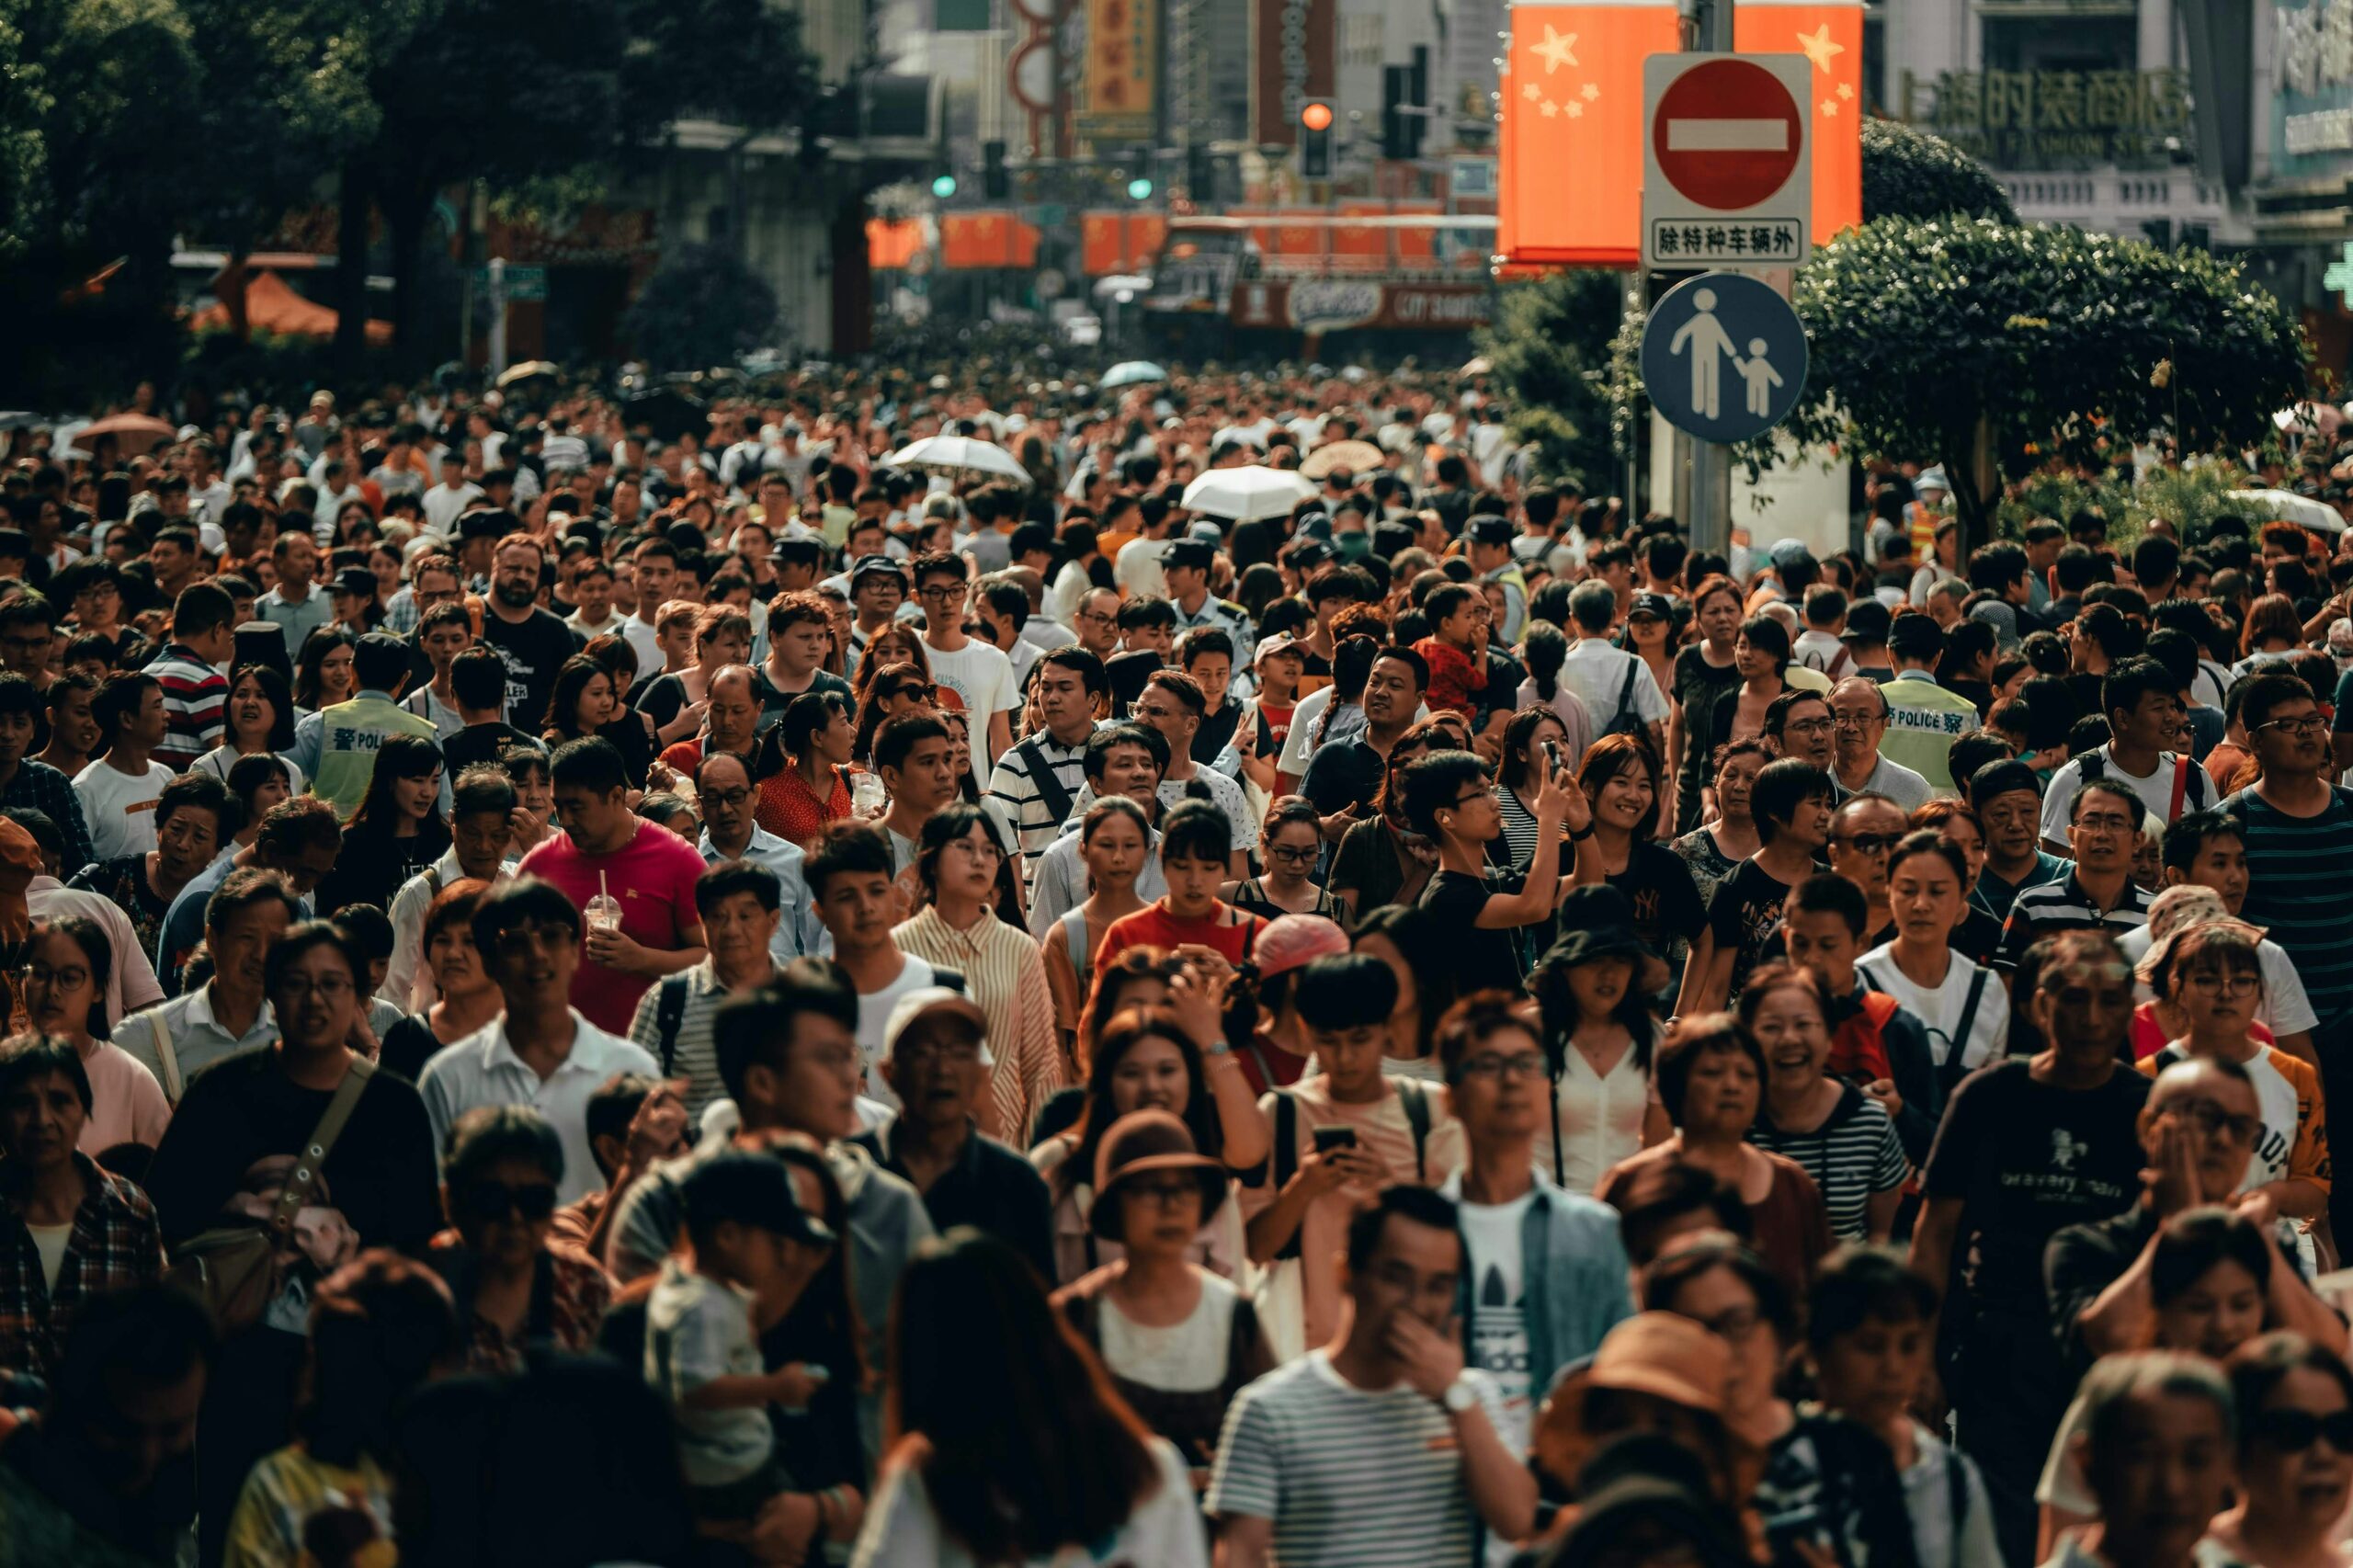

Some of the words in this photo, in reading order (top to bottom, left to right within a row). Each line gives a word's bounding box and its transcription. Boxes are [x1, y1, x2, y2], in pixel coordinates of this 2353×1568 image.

[1658, 225, 1794, 255] 除特种车辆外
[1897, 710, 1940, 729] POLICE
[1943, 713, 1963, 733] 察
[333, 728, 356, 751] 警
